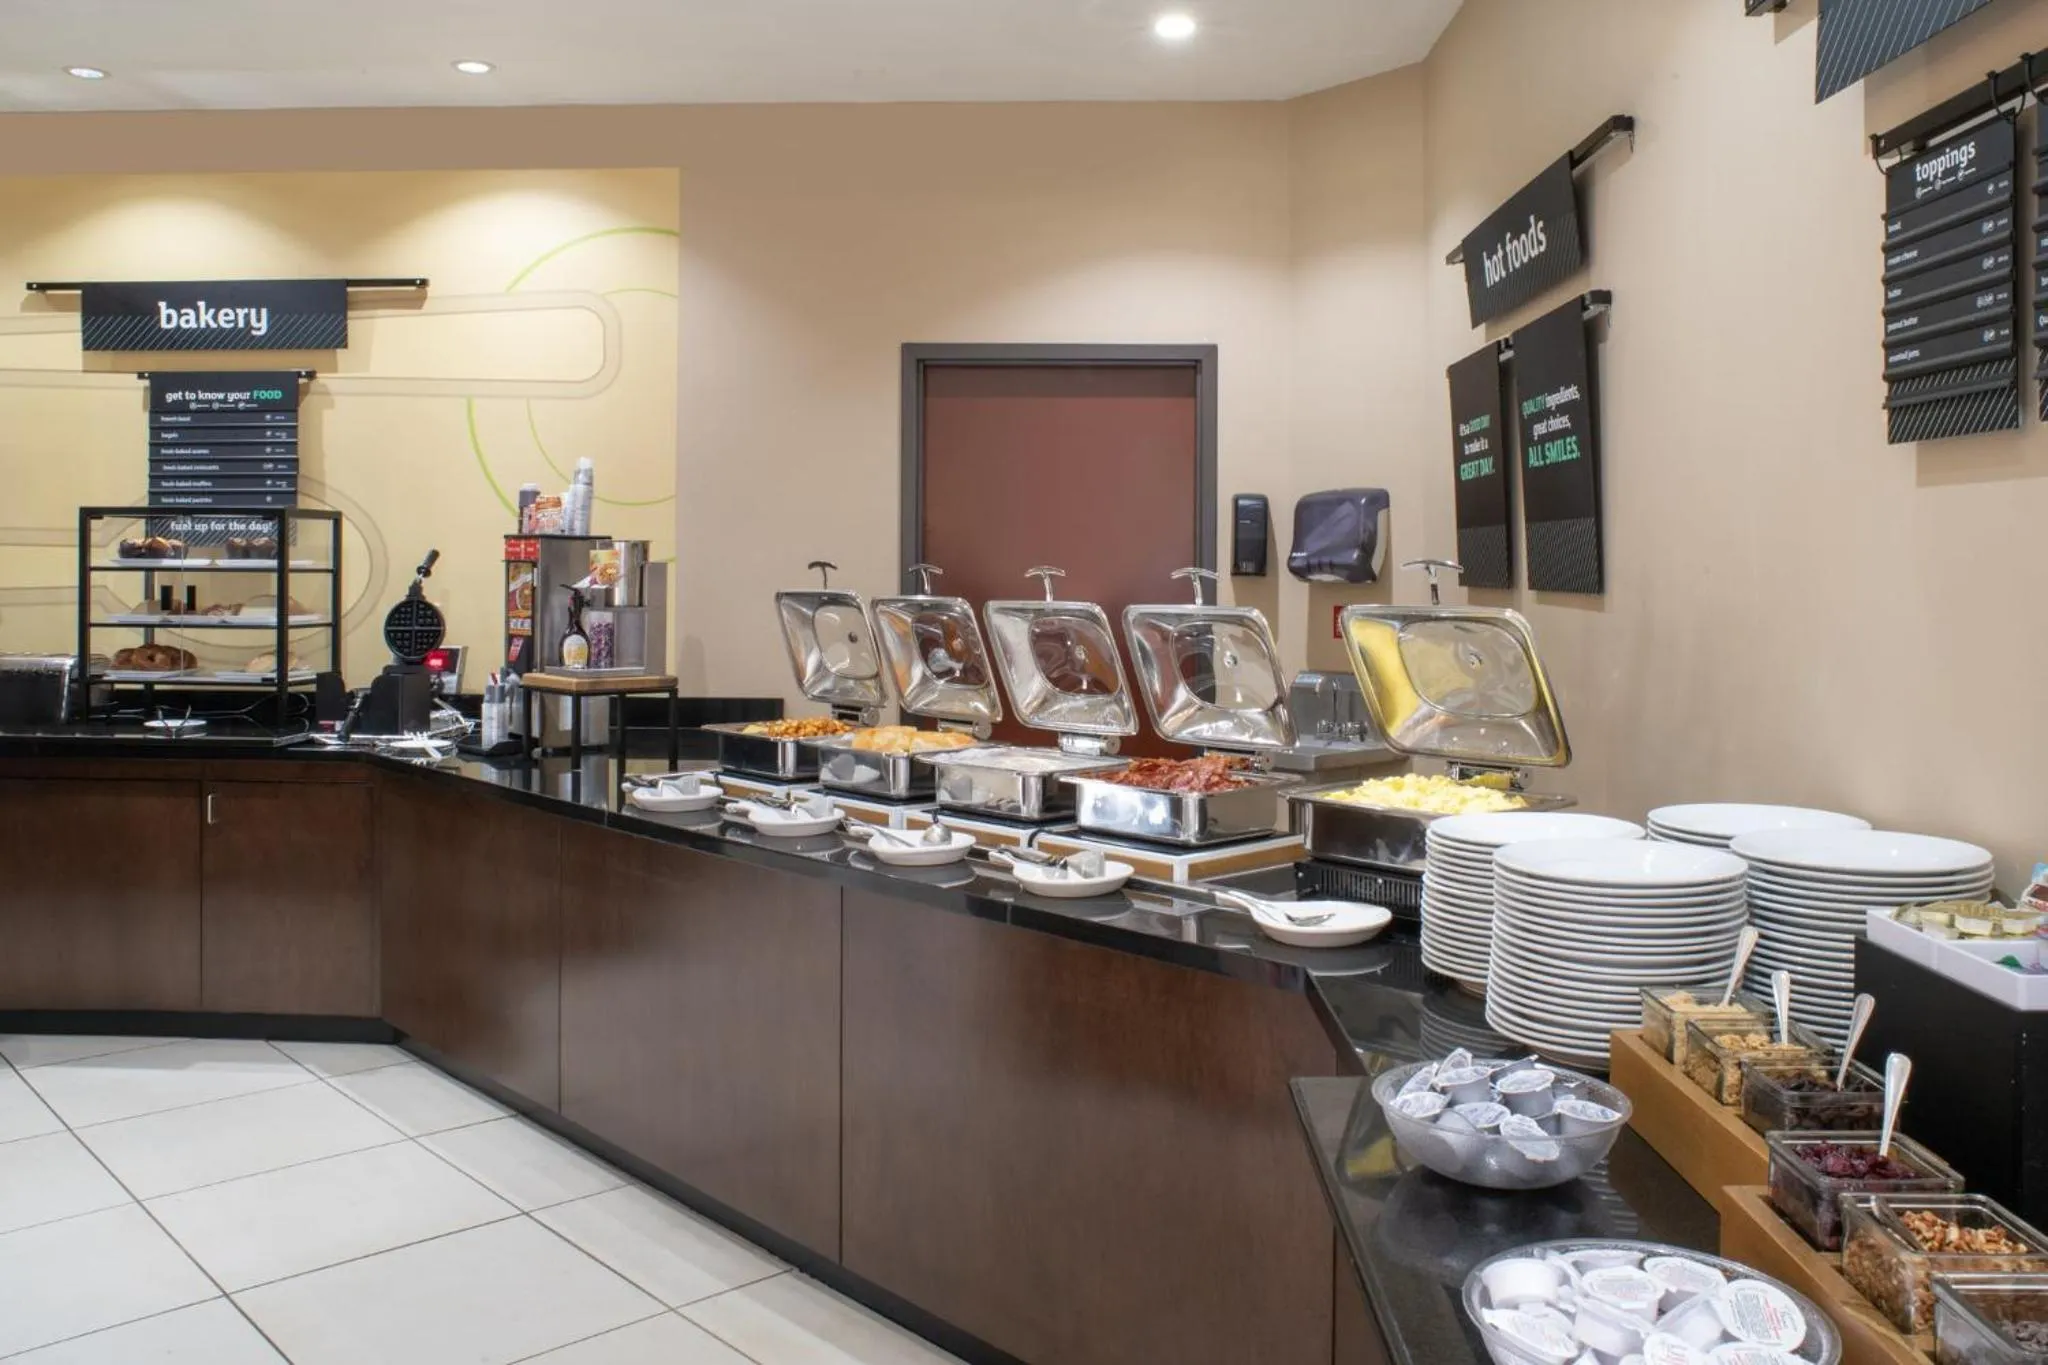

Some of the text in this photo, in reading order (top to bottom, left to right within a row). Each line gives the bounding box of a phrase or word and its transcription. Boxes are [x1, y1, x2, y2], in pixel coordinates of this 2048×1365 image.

[1915, 141, 1976, 182] toppings
[1483, 214, 1547, 288] hot foods
[157, 300, 268, 336] bakery
[166, 389, 282, 403] get to know your FOOD
[1528, 445, 1544, 468] ALL
[1460, 459, 1479, 481] GREAT
[171, 521, 273, 534] fuel up for the day!
